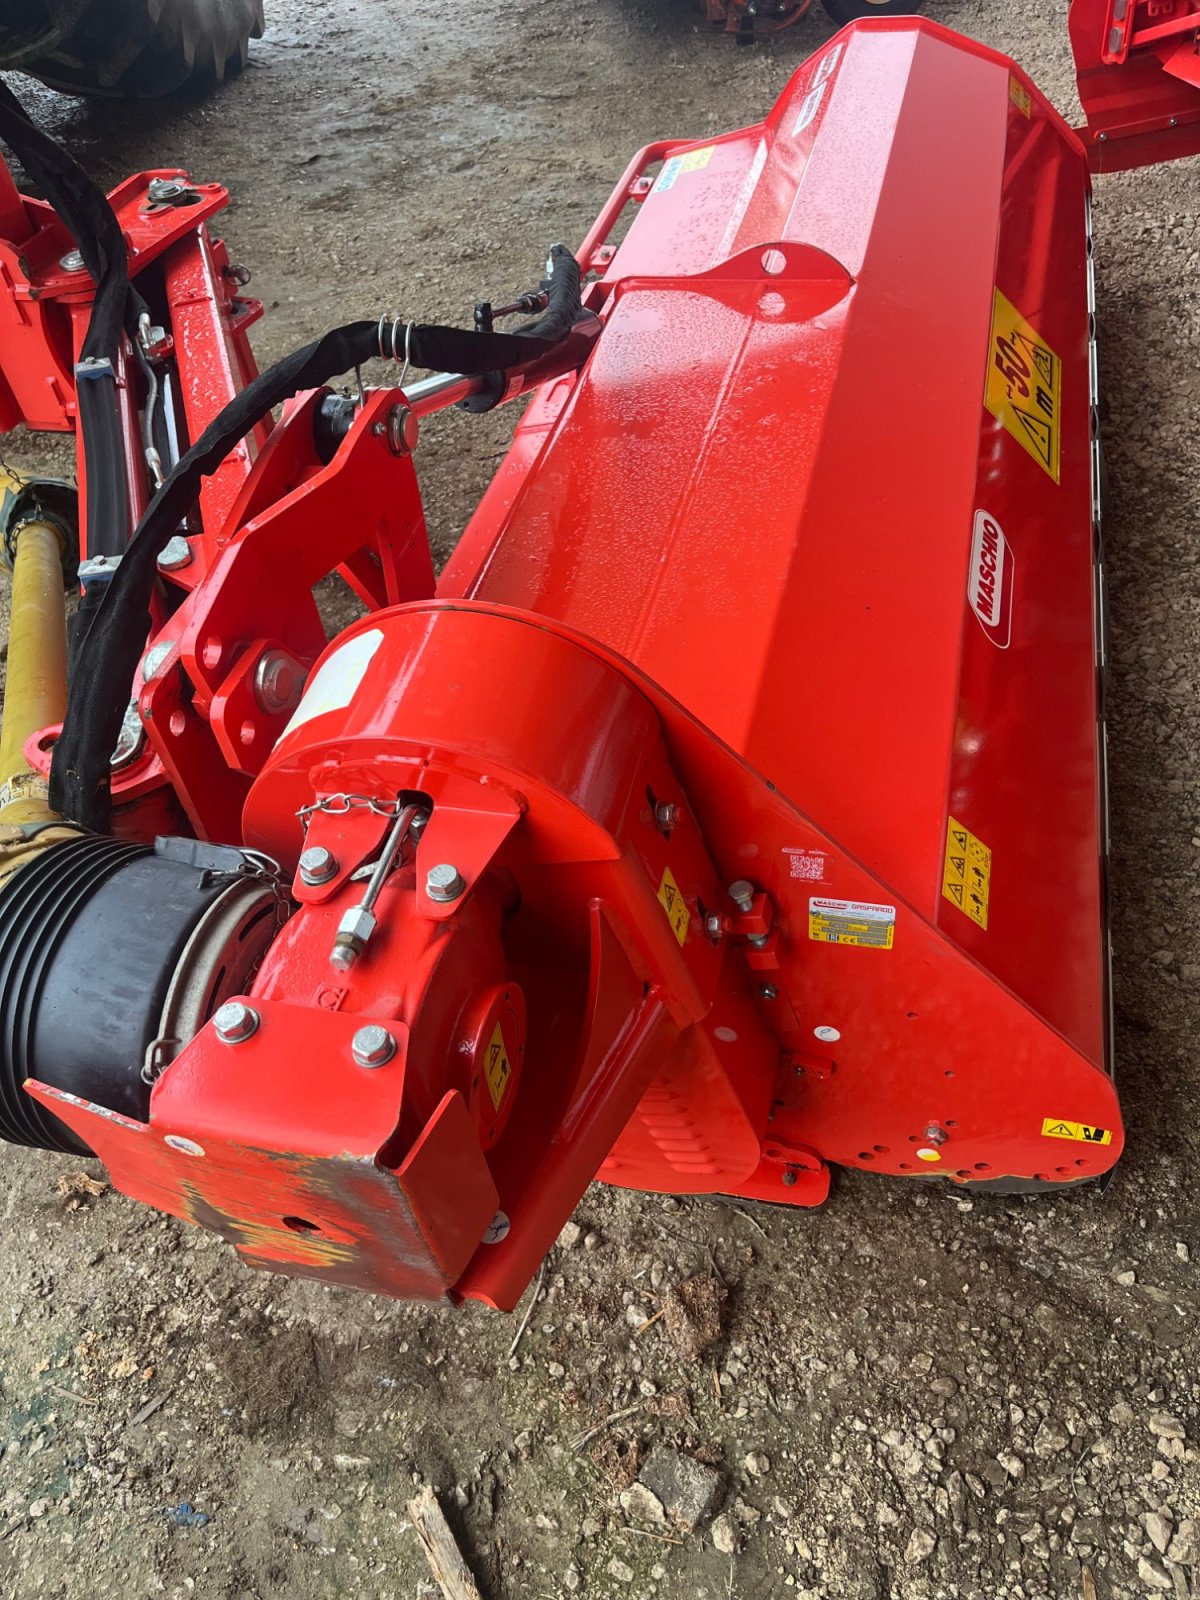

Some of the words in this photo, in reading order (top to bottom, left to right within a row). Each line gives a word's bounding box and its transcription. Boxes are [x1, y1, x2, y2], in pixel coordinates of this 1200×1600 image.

[995, 335, 1031, 398] 50
[976, 519, 999, 622] MASCHIO
[816, 900, 848, 908] MASCHIO
[851, 903, 893, 914] GASPARDO
